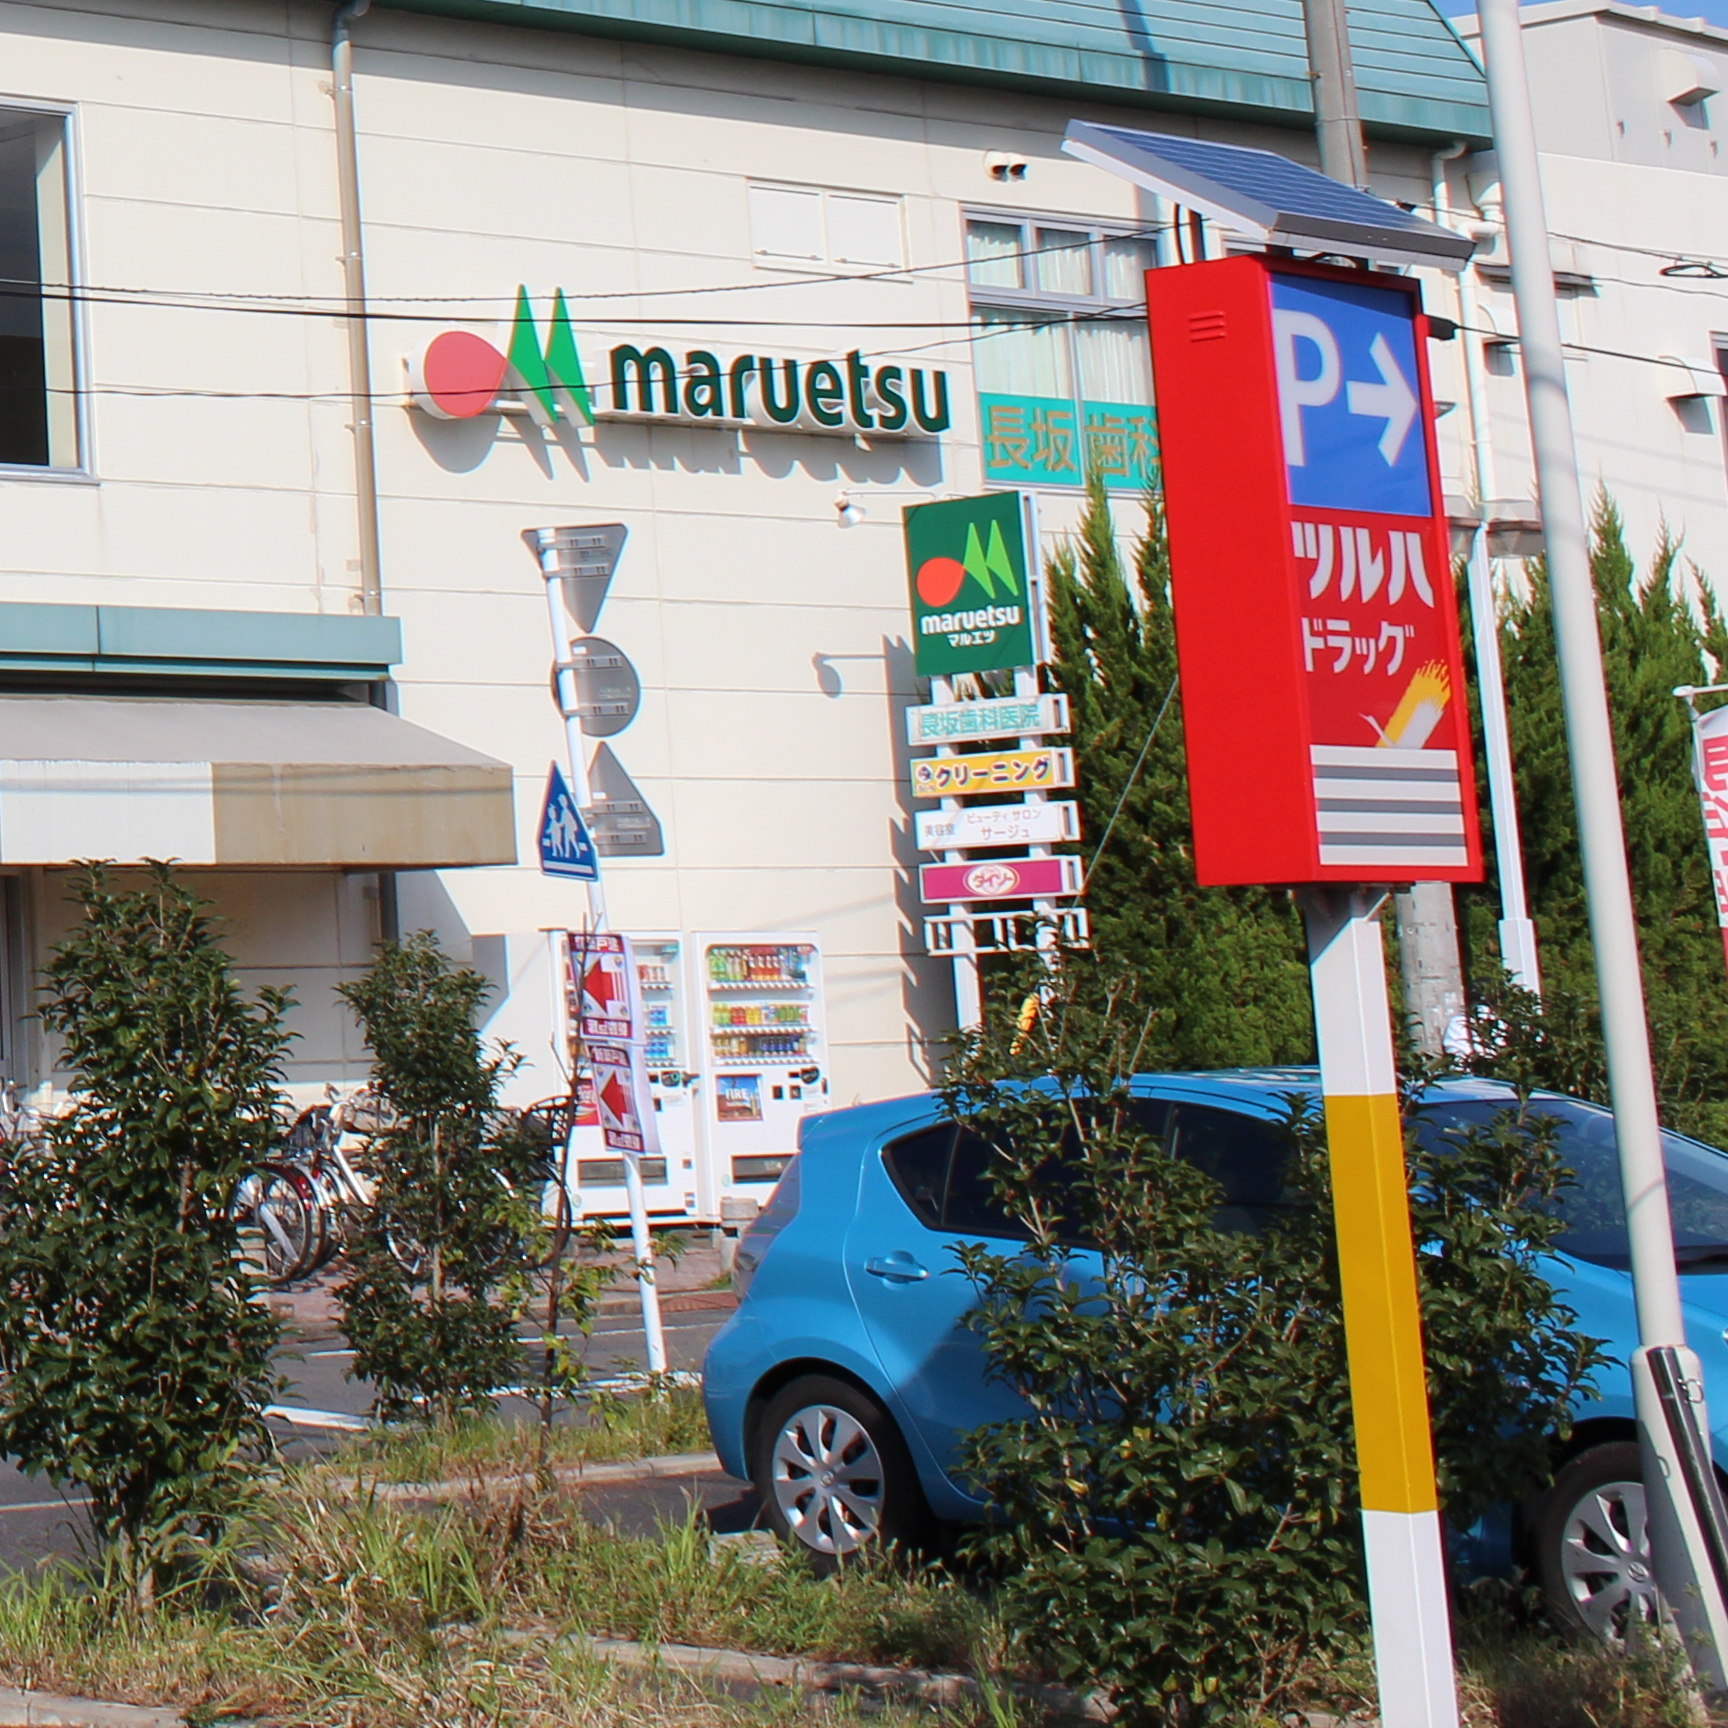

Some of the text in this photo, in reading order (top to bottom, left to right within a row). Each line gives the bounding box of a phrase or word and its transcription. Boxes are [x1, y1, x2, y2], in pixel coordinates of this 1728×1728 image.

[610, 344, 950, 433] maruetsu
[1273, 307, 1341, 467] P
[1290, 520, 1435, 609] ツルハ
[920, 605, 1022, 635] maruetsu
[947, 629, 997, 648] マルエツ
[1300, 617, 1416, 676] ドラッグ
[921, 703, 1041, 738] 長坂歯科医院
[935, 755, 1050, 788] クリーニング
